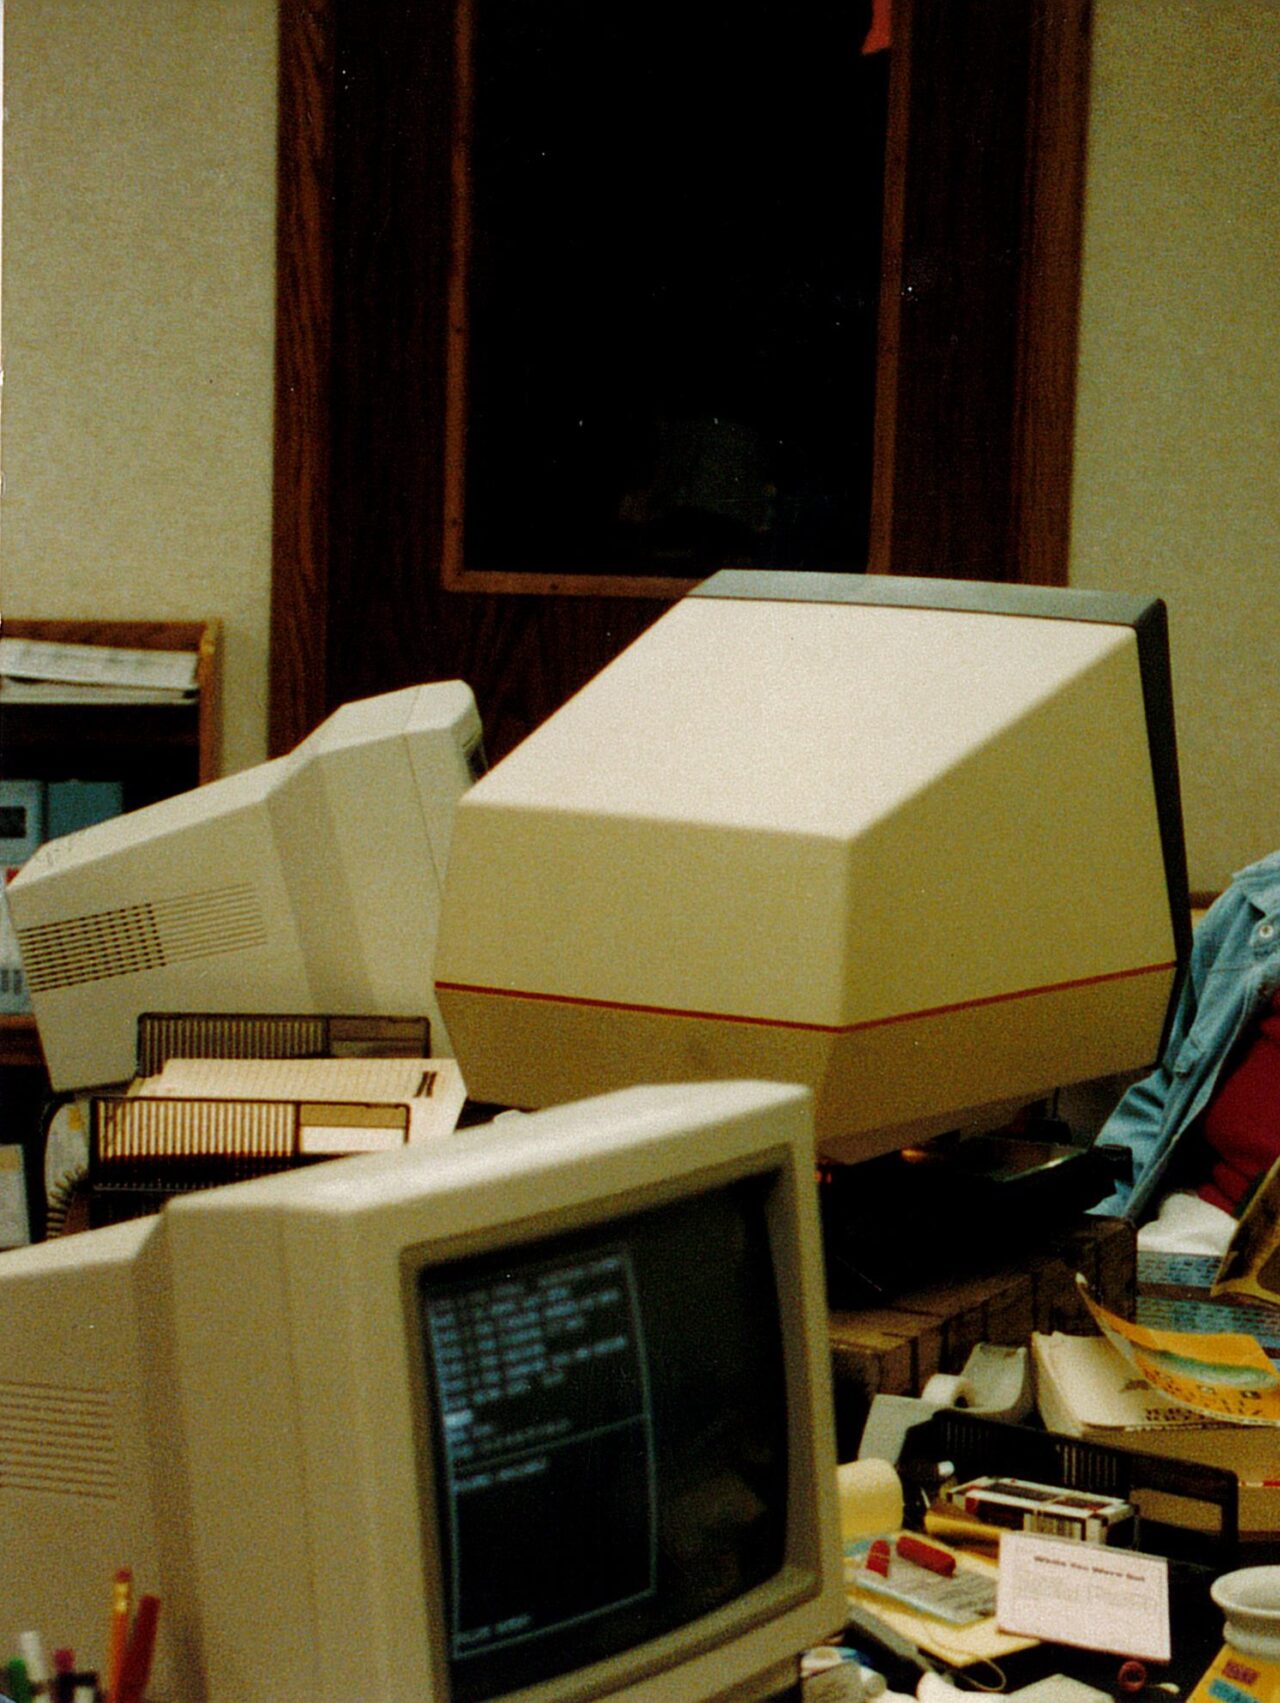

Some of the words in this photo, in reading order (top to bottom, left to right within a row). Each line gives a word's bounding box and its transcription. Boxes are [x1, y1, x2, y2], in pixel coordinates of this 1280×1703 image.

[1034, 1555, 1067, 1567] While
[1070, 1561, 1090, 1571] You
[1092, 1566, 1123, 1577] Were
[1126, 1571, 1145, 1582] Out
